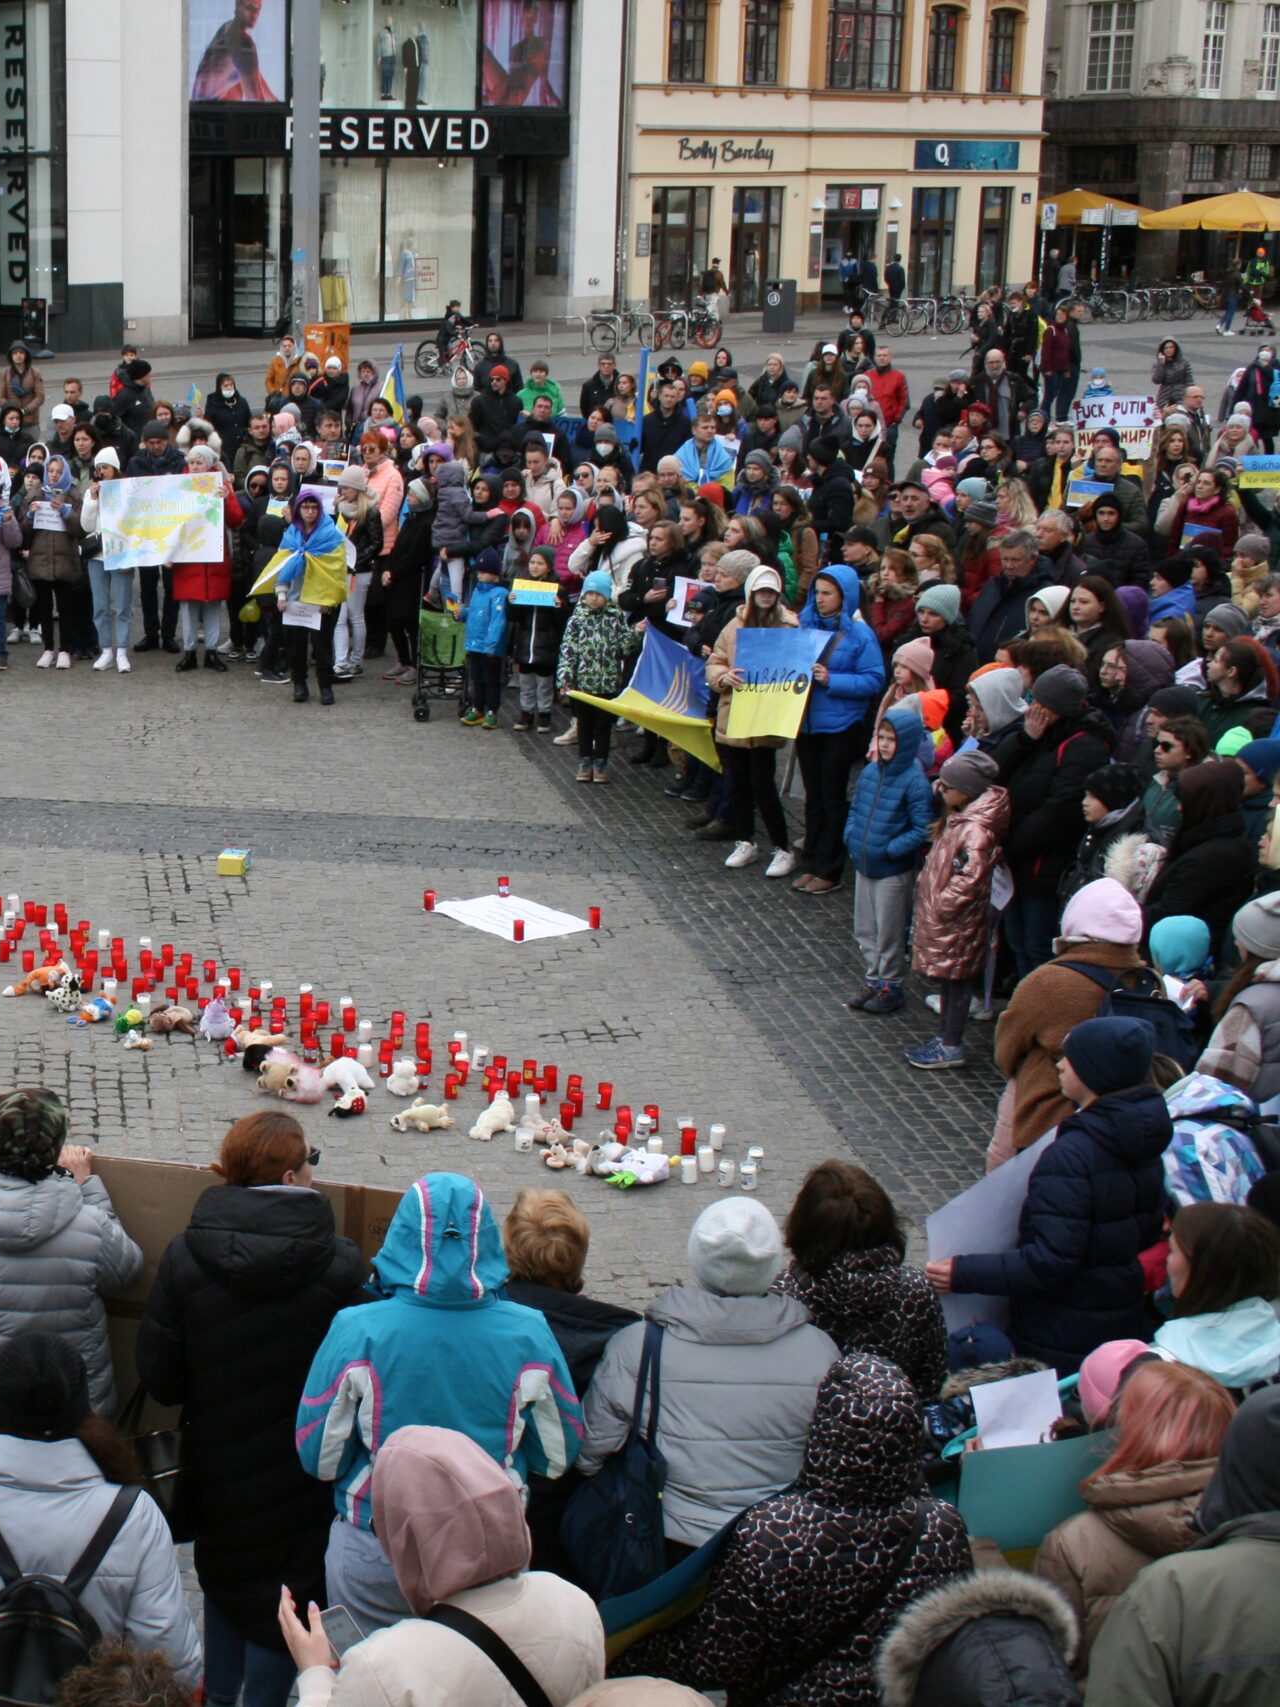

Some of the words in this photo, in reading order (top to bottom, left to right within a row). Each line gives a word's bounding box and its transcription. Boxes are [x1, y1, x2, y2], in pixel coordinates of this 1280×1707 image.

[4, 24, 28, 284] RESERVED
[678, 138, 712, 170] Betty
[720, 138, 773, 170] Barclay
[1076, 403, 1106, 420] FUCK
[1113, 400, 1147, 416] PUTIN
[1121, 428, 1152, 444] МИР!
